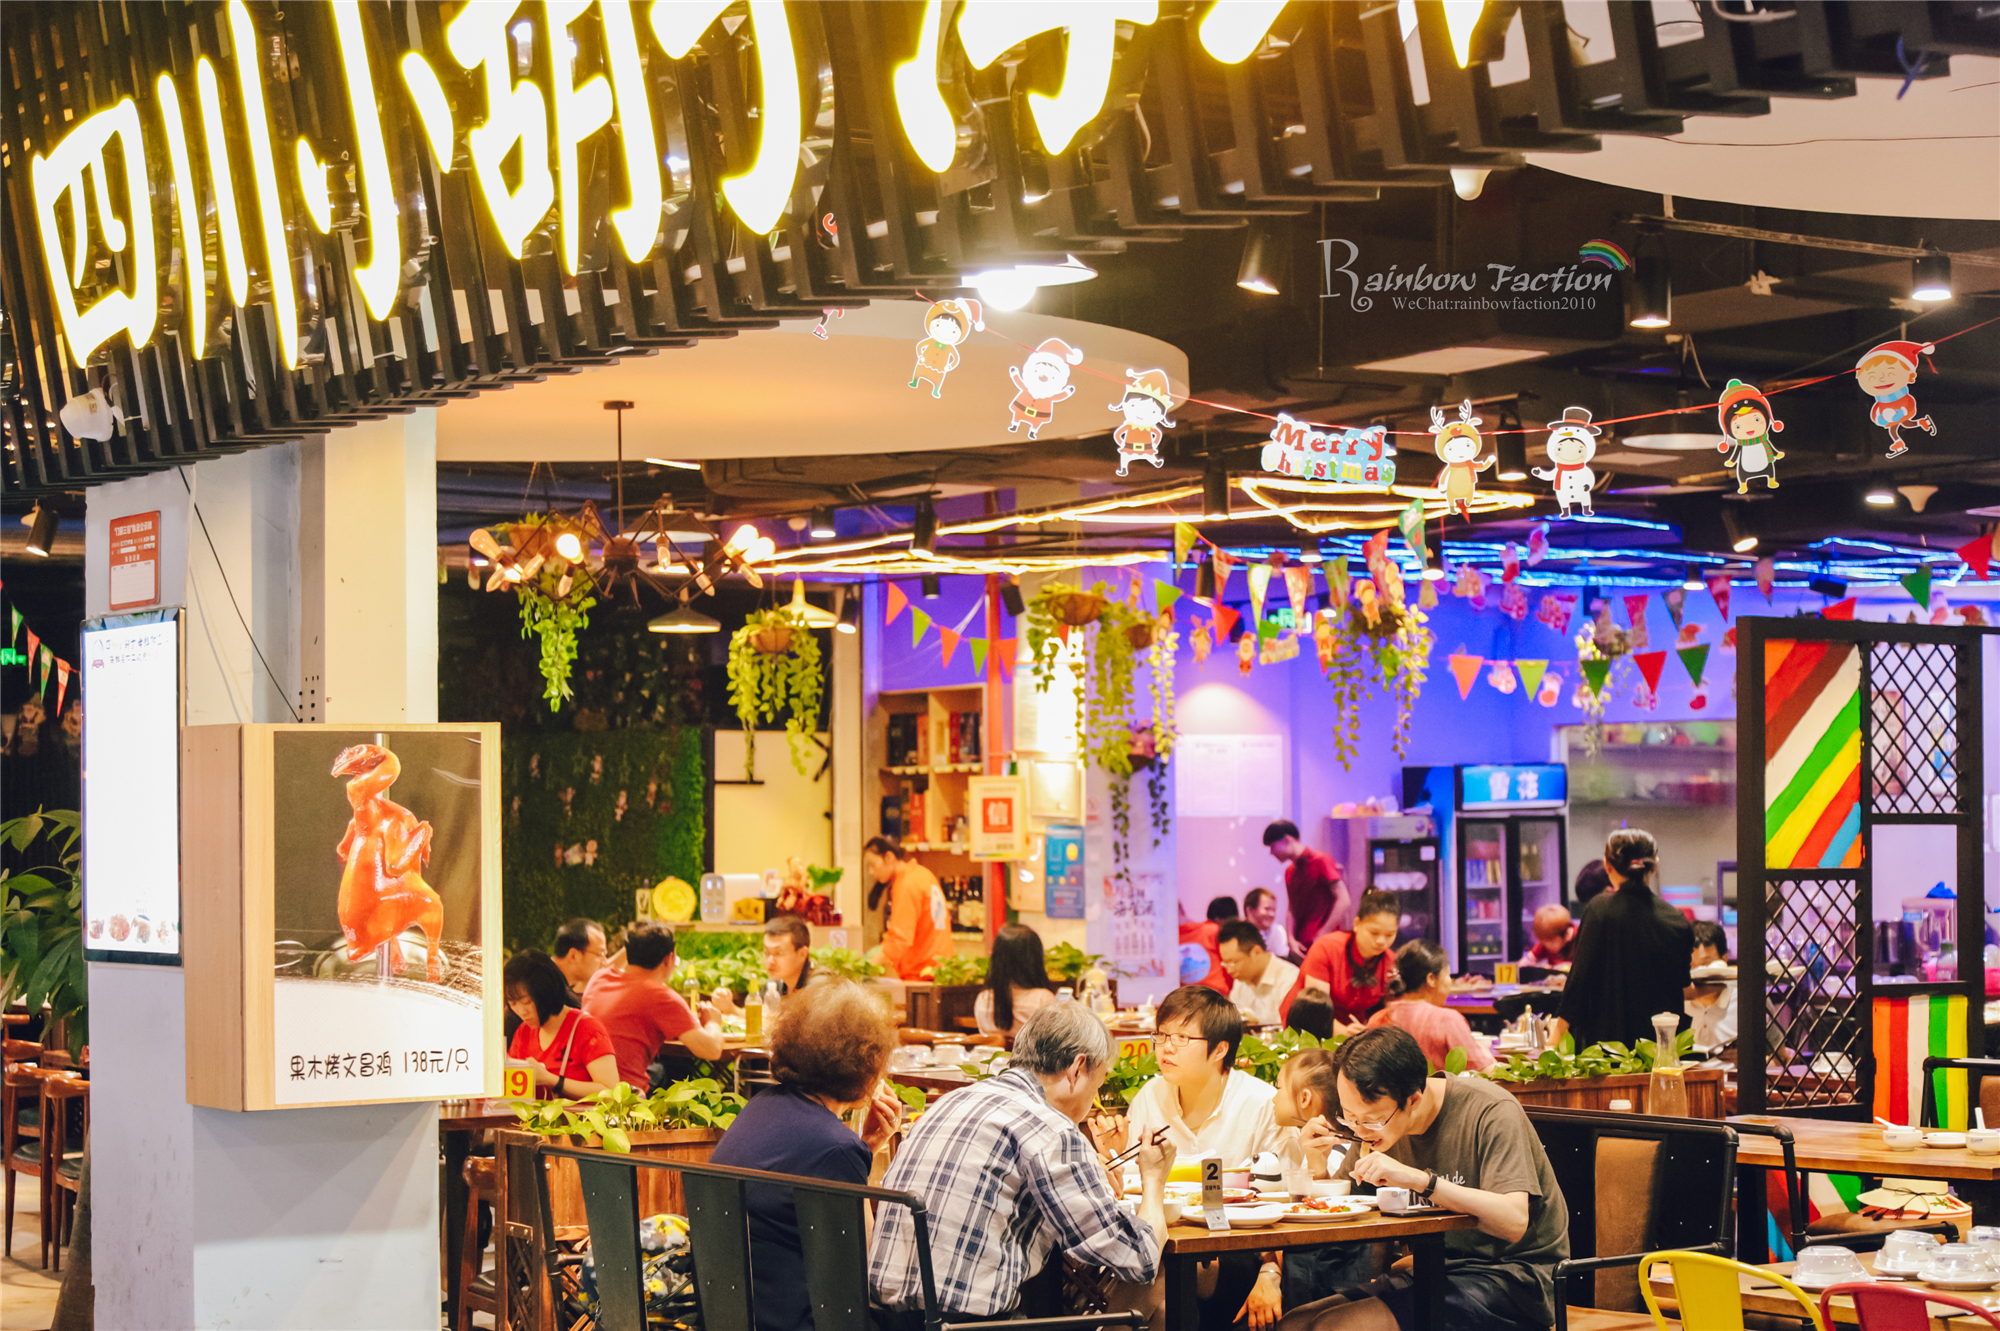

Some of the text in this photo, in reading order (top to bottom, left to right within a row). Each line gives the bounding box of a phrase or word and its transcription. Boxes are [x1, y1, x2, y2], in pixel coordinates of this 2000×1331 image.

[1272, 421, 1385, 461] Merry
[1499, 965, 1512, 983] 17
[289, 1047, 470, 1081] 果木烤文昌鸡 138元/只
[1206, 1162, 1219, 1181] 2
